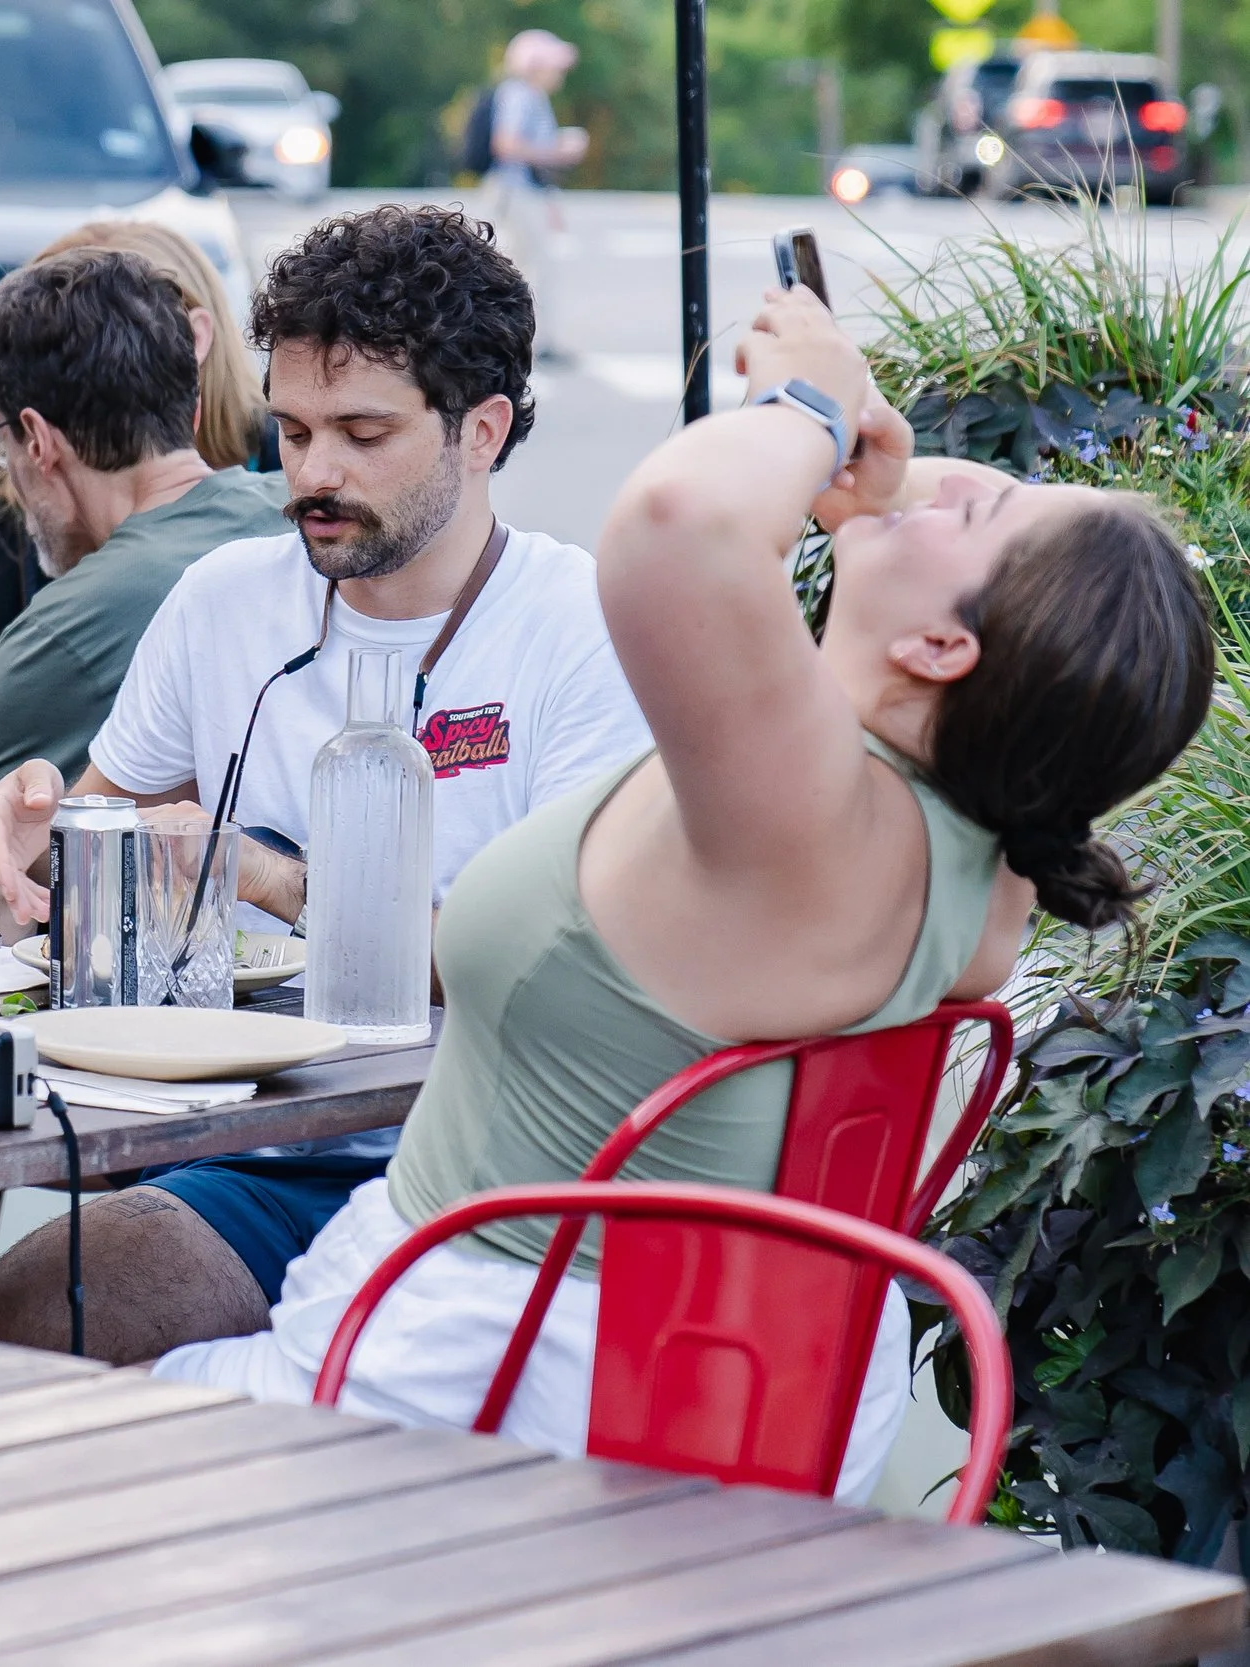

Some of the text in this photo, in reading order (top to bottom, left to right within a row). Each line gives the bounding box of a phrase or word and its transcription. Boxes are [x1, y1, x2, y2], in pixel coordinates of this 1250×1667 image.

[448, 706, 501, 722] SOUTHERN TIER
[422, 715, 497, 751] Spicy
[429, 725, 509, 768] eatballs
